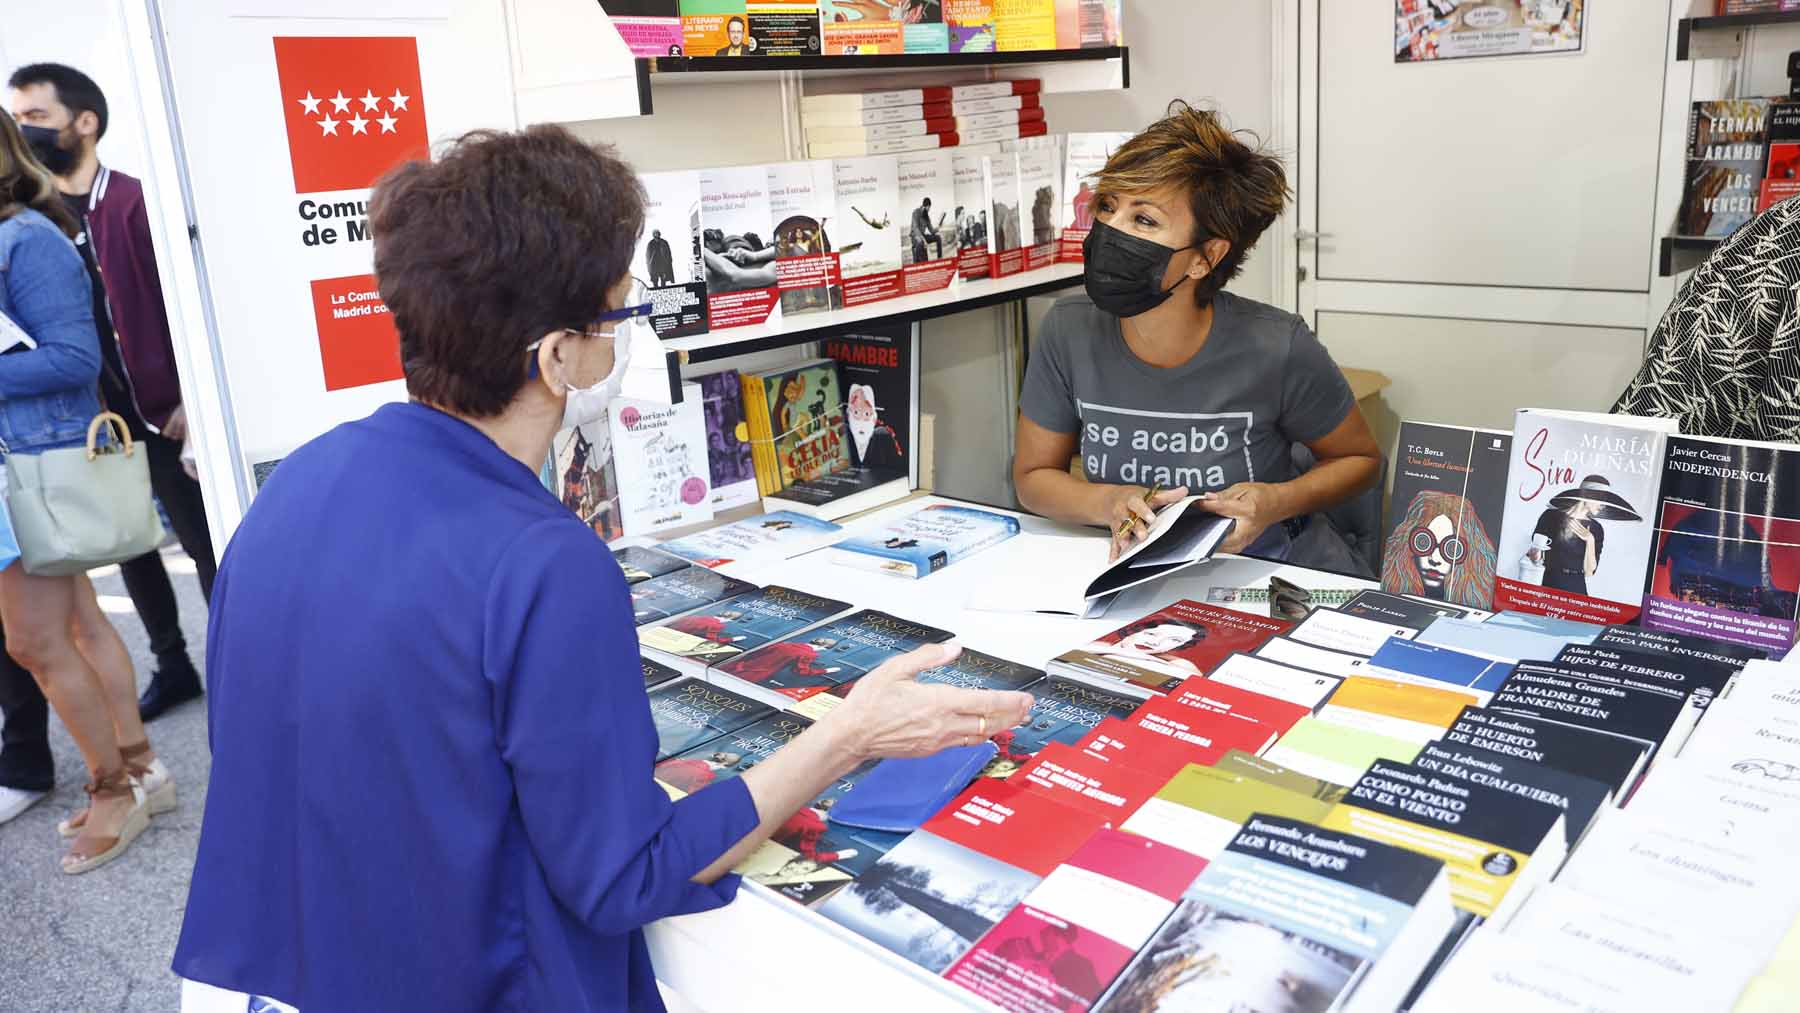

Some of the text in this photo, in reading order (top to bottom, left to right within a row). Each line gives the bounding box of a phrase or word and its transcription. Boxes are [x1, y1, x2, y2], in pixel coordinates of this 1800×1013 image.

[1726, 173, 1752, 189] LOS
[302, 224, 338, 247] de
[331, 294, 344, 305] La
[333, 306, 372, 320] Madrid
[828, 341, 899, 368] HAMBRE
[1086, 422, 1229, 453] se acabó
[1578, 432, 1651, 458] MARÍA
[1519, 427, 1577, 501] Sira
[1564, 447, 1652, 475] DUEÑAS
[1670, 446, 1731, 463] Javier Cercas
[1087, 453, 1226, 488] el drama
[1669, 461, 1773, 484] INDEPENDENCIA
[1221, 612, 1243, 622] DEL
[1650, 600, 1659, 608] Un
[1567, 646, 1620, 660] Alan Parks
[1637, 640, 1670, 652] PARA
[1560, 655, 1685, 682] HIJOS DE FEBRERO
[1503, 684, 1603, 706] LA MADRE DE
[1512, 672, 1627, 698] Almudena Grandes
[1497, 693, 1610, 721] FRANKENSTEIN
[1454, 722, 1536, 748] EL HUERTO
[1463, 711, 1536, 735] Luis Landero
[1426, 746, 1505, 773] Fran Lebowitz
[1448, 731, 1544, 762] DE EMERSON
[1372, 763, 1469, 797] Leonardo Padura
[1416, 757, 1569, 808] UN DÍA CUALQUIERA
[1352, 786, 1461, 824] EN EL VIENTO
[1361, 776, 1467, 812] COMO POLVO
[1249, 819, 1302, 839] Fernando
[1235, 833, 1348, 871] LOS VENCEJOS
